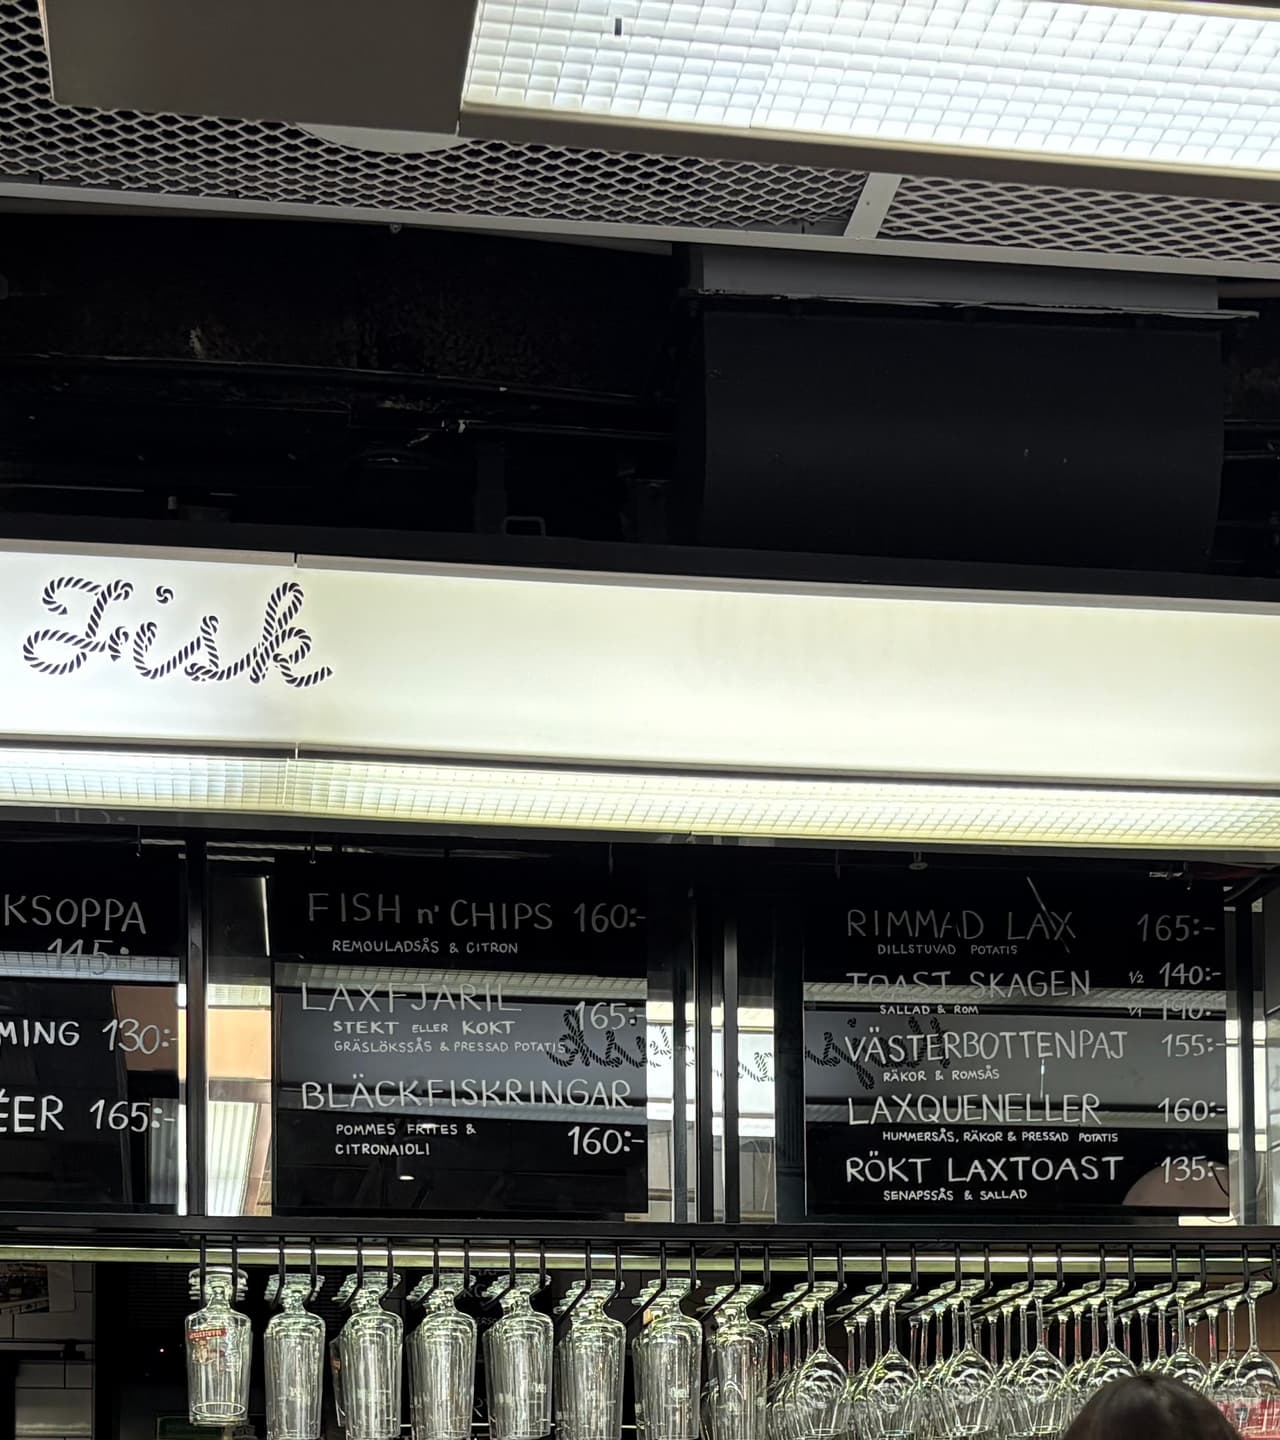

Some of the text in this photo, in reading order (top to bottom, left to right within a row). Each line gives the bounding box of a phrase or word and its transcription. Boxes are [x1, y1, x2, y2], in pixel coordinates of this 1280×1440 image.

[22, 575, 333, 689] Fisk
[308, 893, 401, 924] FISH
[450, 900, 553, 930] CHIPS
[573, 902, 646, 933] 160:-
[847, 909, 1215, 942] RIMMAD LAX 165:-
[332, 937, 519, 954] REMOULADSÅS & CITRON
[877, 944, 1018, 955] DILLSTUVAD POTATIS
[846, 971, 951, 999] TOAST
[970, 970, 1090, 998] SKAGEN
[1159, 962, 1222, 987] 140:-
[880, 1005, 979, 1015] SALLAD & ROM
[102, 1018, 178, 1054] 130:-
[333, 1021, 516, 1035] STEKT ELLER KOKT
[334, 1037, 566, 1053] GRÄSLÖKSSÅS & PRESSAD POTATIS
[845, 1026, 1225, 1066] VÄSTERBOTTENPAJ 155:-
[883, 1066, 1000, 1082] RÄKOR & ROMSÅS
[302, 1074, 632, 1110] BLÄCKFISKRINGAR
[88, 1099, 176, 1133] 165:-
[848, 1093, 1225, 1126] LAXQUENELLER 160:-
[336, 1124, 396, 1136] POMMES
[466, 1124, 476, 1135] &
[568, 1125, 645, 1156] 160:-
[963, 1130, 1003, 1142] RÄKOR
[1007, 1131, 1016, 1142] &
[1022, 1131, 1068, 1143] PRESSAD
[1079, 1132, 1118, 1143] POTATIS
[335, 1143, 430, 1156] CITRONAIOLI
[846, 1151, 1226, 1183] RÖKT LAXTOAST 135:-
[884, 1186, 1027, 1200] SENAPSSÅS & SALLAD
